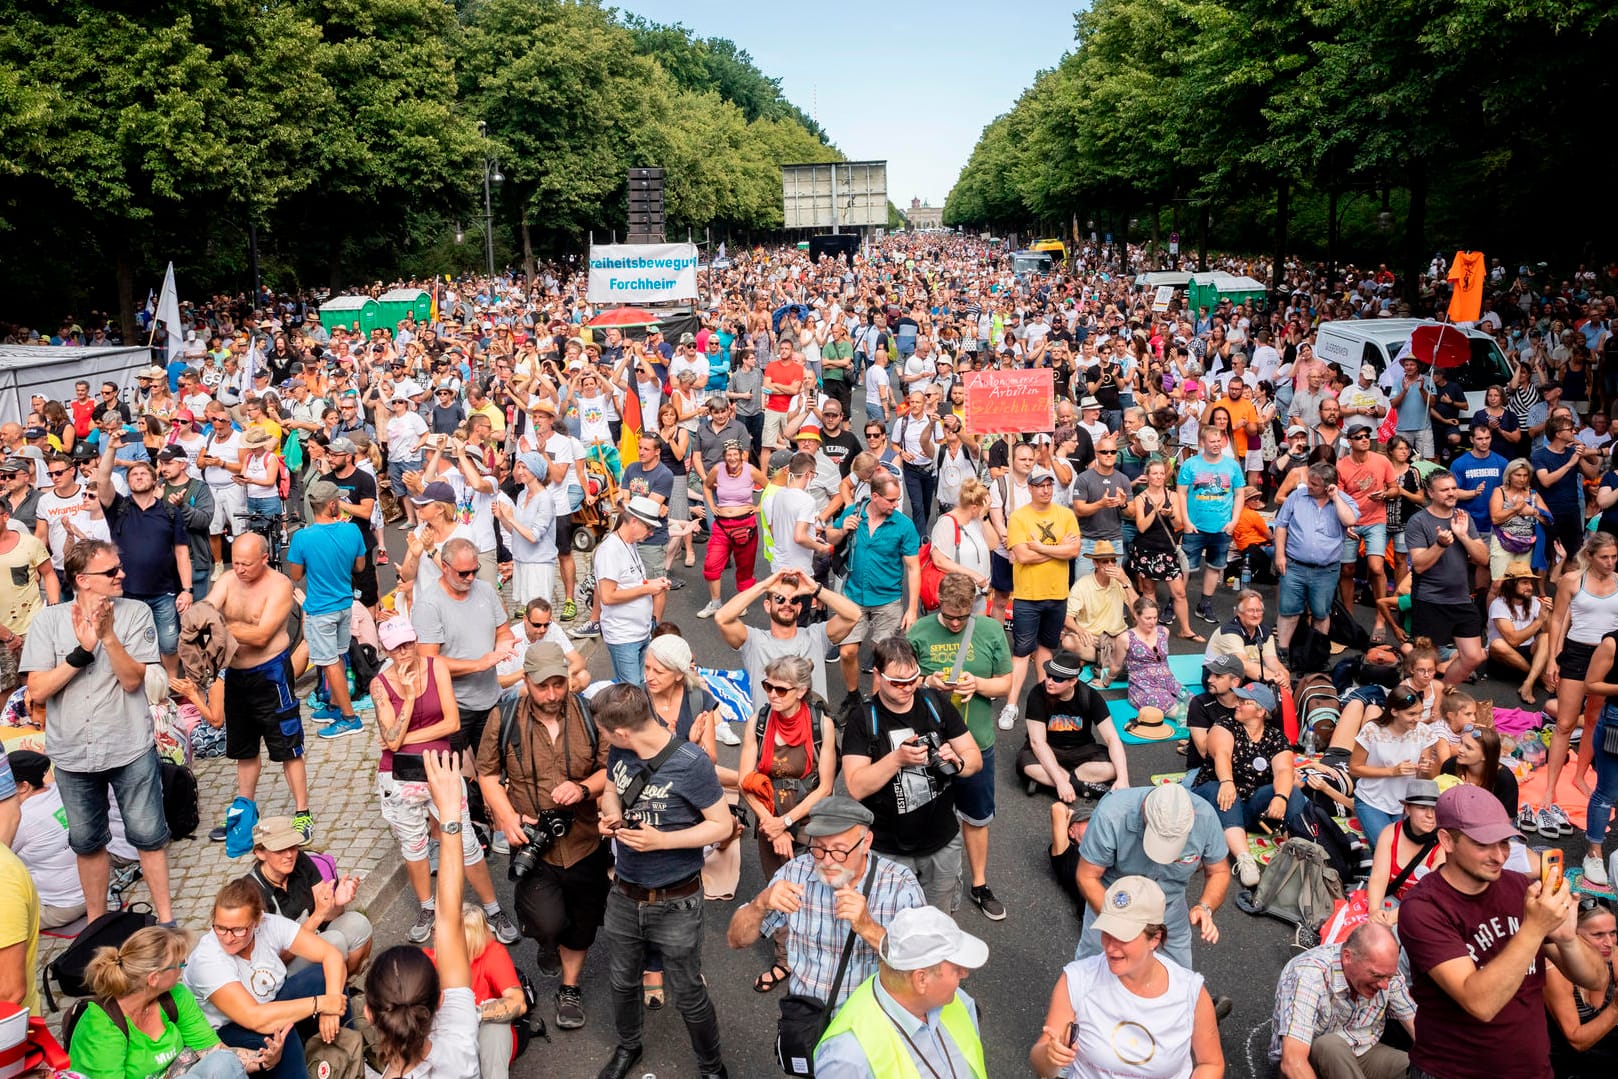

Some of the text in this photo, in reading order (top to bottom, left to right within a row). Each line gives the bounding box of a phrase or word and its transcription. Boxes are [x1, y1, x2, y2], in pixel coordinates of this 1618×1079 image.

[609, 277, 677, 290] Forchheim
[48, 503, 81, 516] Wrangl
[930, 650, 976, 664] ROOS
[1465, 916, 1520, 963] PHOEN
